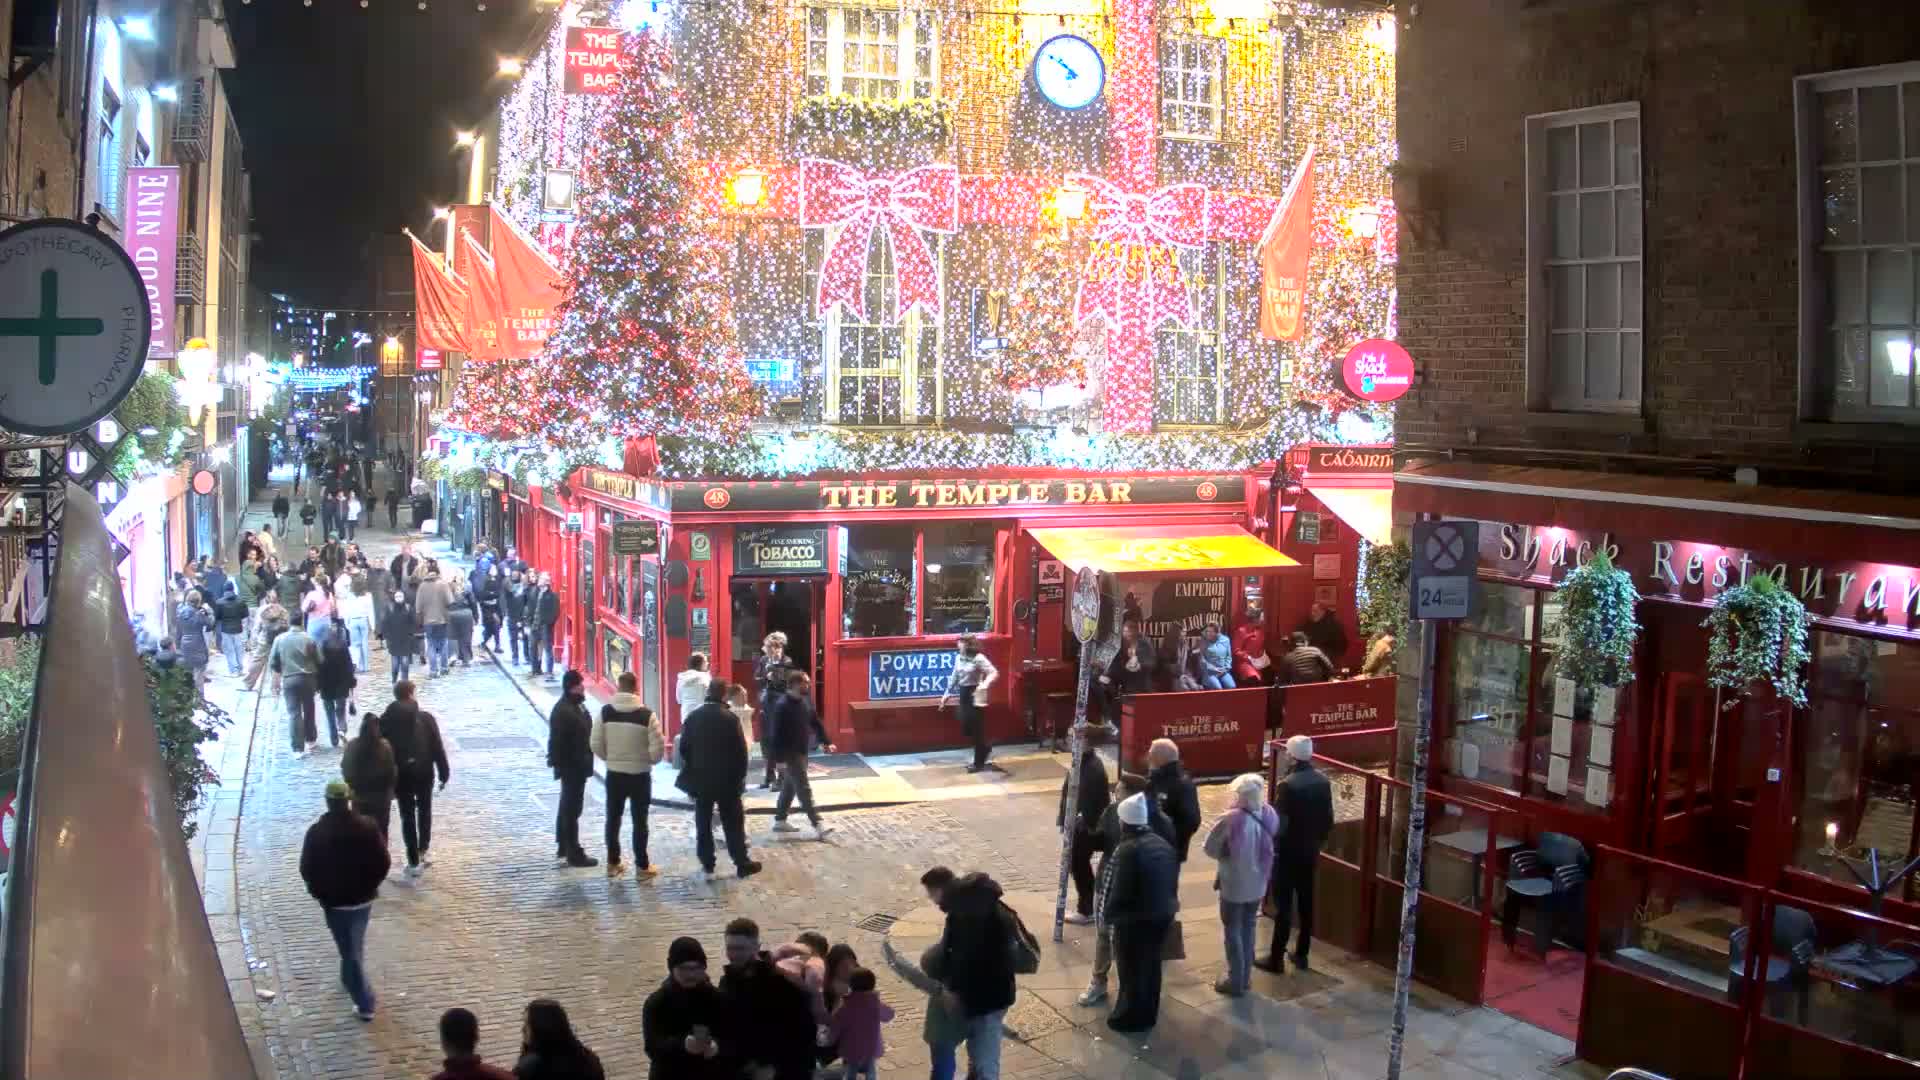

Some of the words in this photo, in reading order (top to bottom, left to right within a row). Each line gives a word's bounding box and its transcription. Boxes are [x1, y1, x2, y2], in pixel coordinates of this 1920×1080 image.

[584, 33, 616, 49] THE
[136, 174, 169, 236] NINE
[1088, 240, 1178, 266] MERRY
[520, 307, 545, 318] THE
[87, 304, 137, 408] PHARMACY
[709, 490, 725, 504] 48
[822, 485, 898, 508] THE
[911, 483, 1051, 506] TEMPLE
[1064, 481, 1133, 504] BAR
[788, 538, 815, 547] SMOKING
[1500, 523, 1621, 571] Shack
[748, 543, 815, 566] TOBACCO
[1175, 582, 1225, 597] EMPEROR
[1421, 587, 1443, 608] 24
[1210, 596, 1225, 612] OF
[880, 652, 958, 672] POWER
[1310, 711, 1353, 724] TEMPLE
[1355, 707, 1378, 720] BAR
[1336, 703, 1353, 712] THE
[1192, 715, 1211, 724] THE
[1161, 722, 1211, 737] TEMPLE
[1213, 720, 1240, 732] BAR
